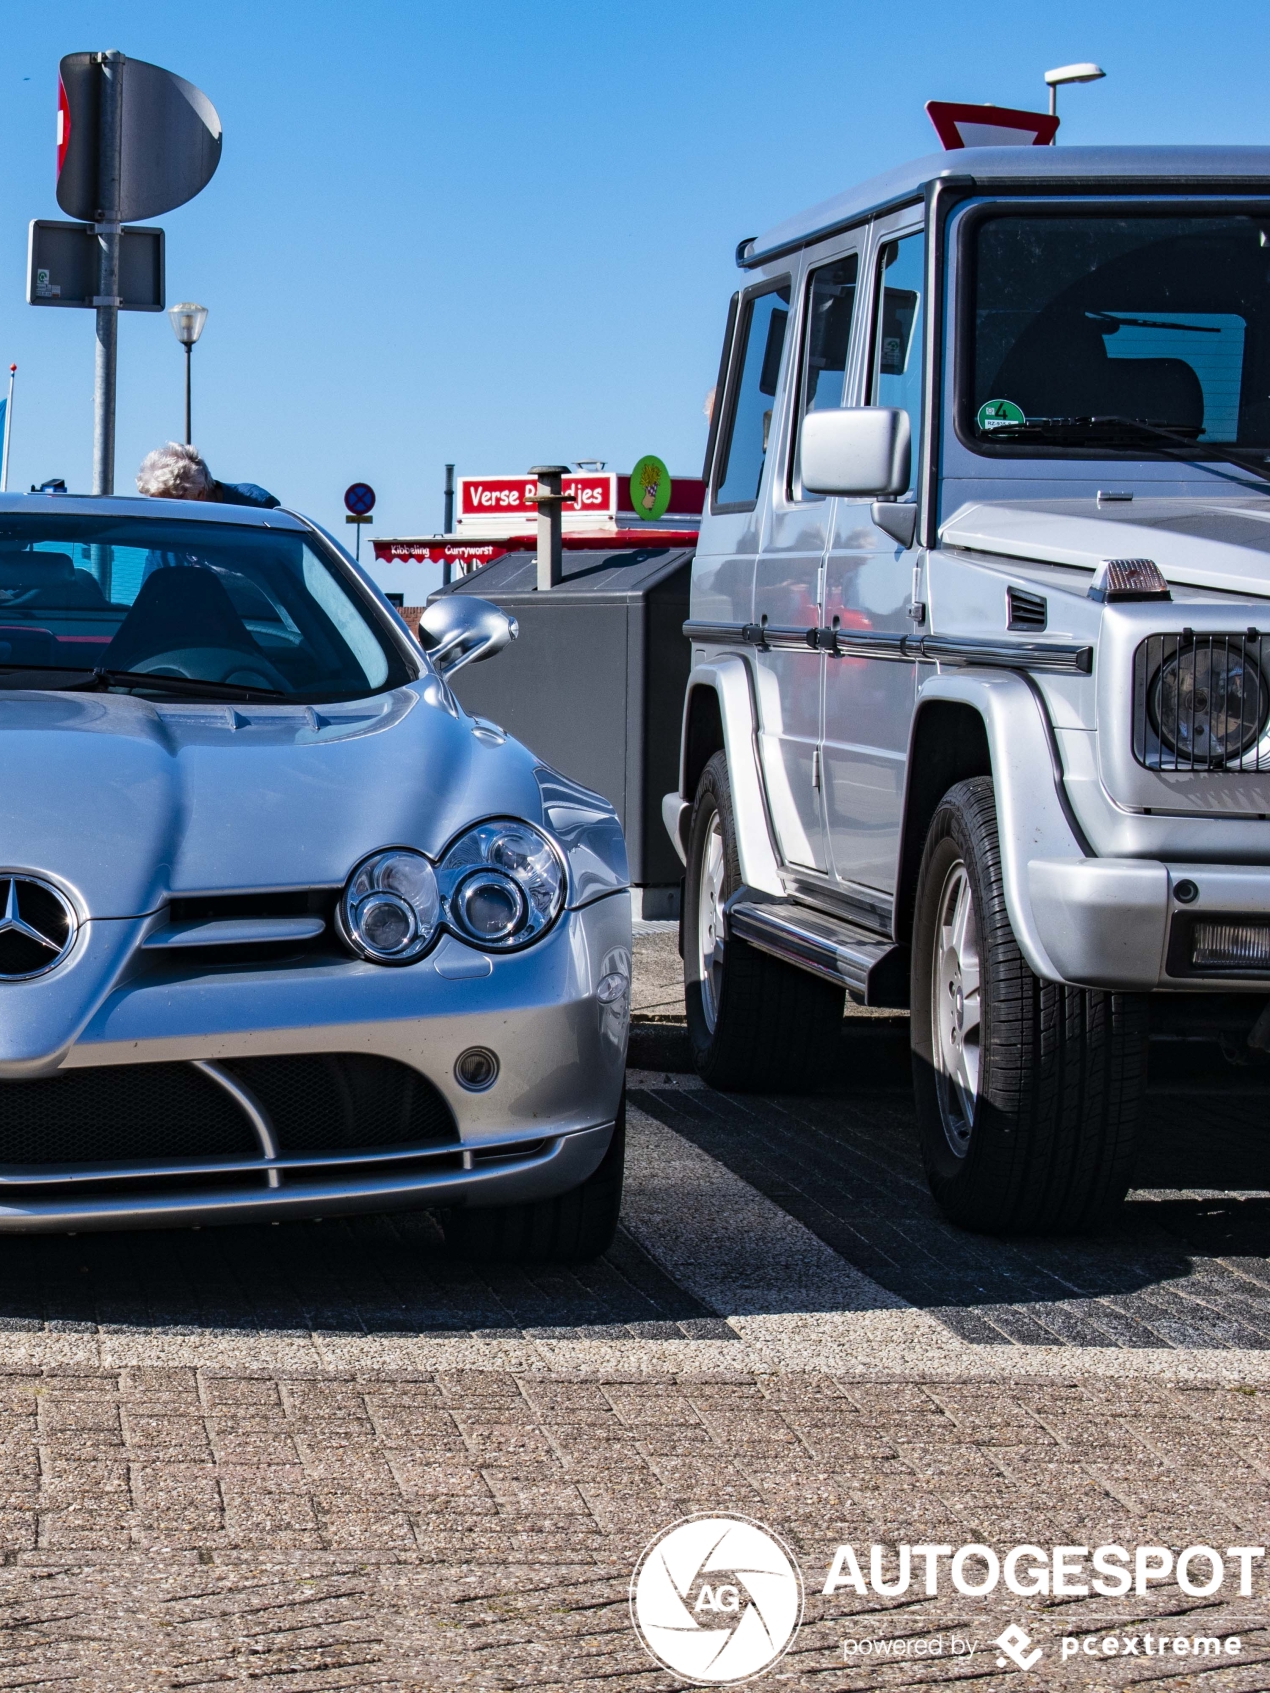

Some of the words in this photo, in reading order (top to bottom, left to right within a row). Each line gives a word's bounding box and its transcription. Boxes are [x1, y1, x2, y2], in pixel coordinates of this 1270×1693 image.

[994, 402, 1008, 420] 4
[469, 485, 520, 507] Verse
[390, 545, 430, 557] Kibbeling
[445, 545, 493, 557] Curryworst
